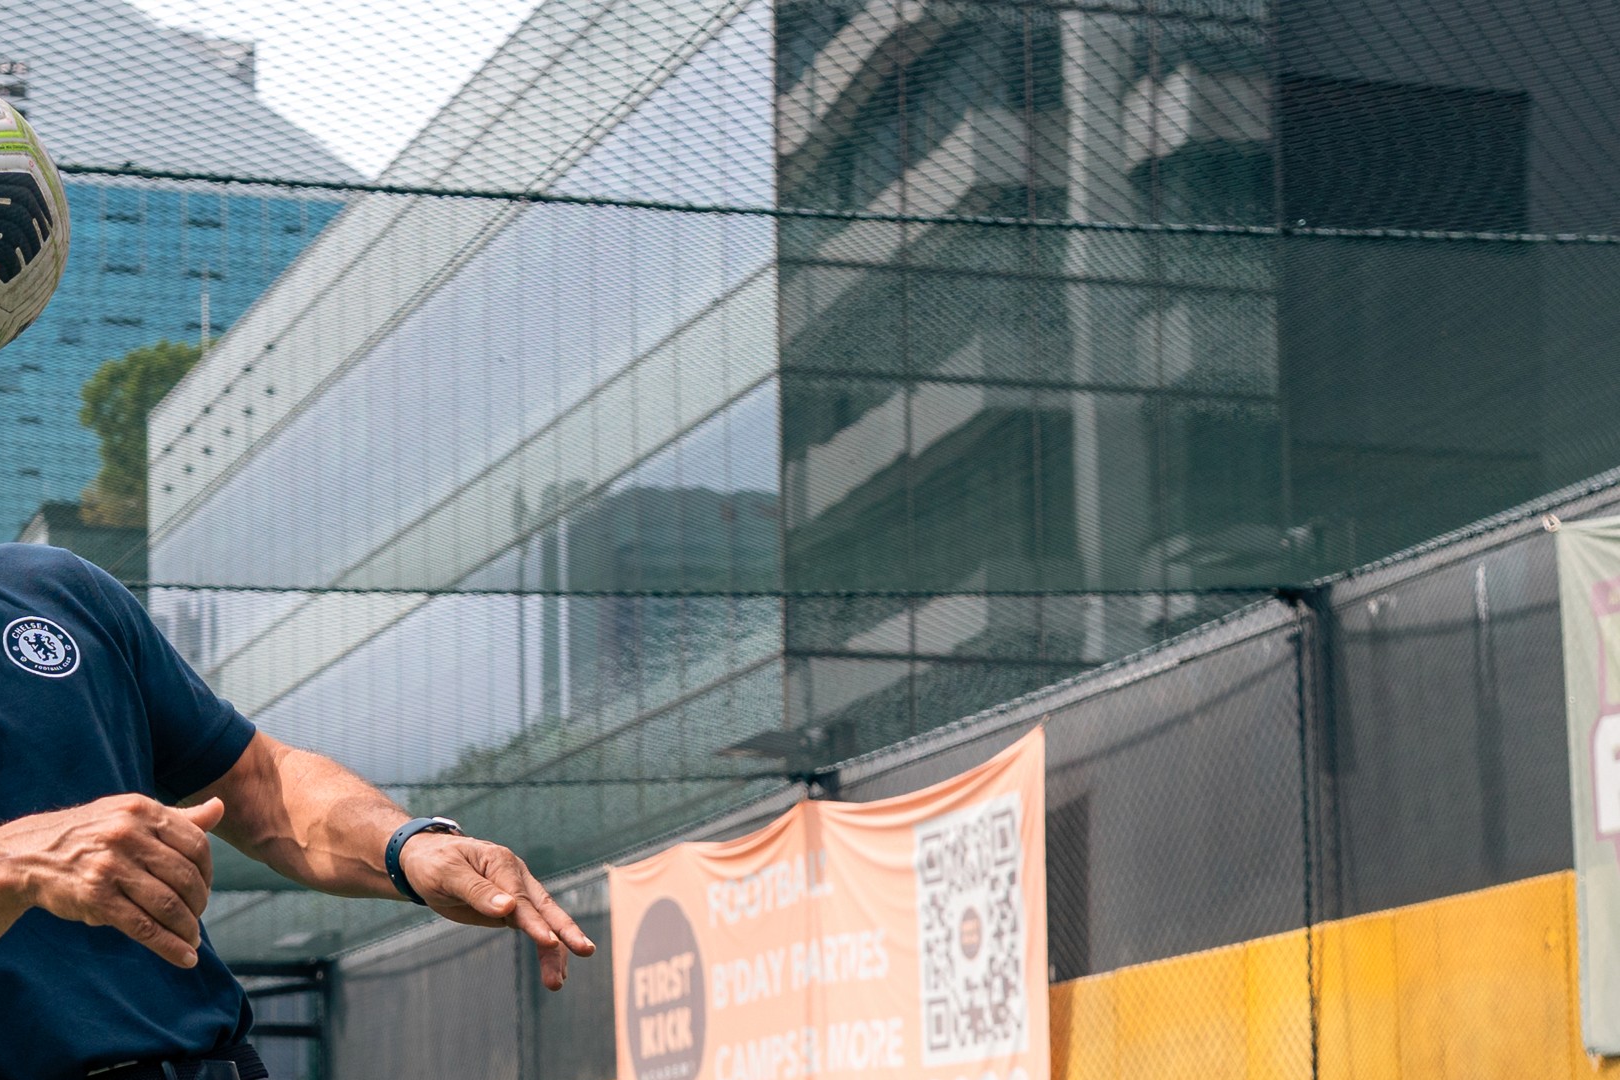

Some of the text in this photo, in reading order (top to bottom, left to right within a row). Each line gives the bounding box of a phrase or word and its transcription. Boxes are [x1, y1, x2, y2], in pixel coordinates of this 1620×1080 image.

[11, 622, 48, 639] CHELSEA
[633, 951, 695, 1010] FIRST
[639, 1007, 694, 1060] KICK
[828, 1017, 905, 1072] MORE
